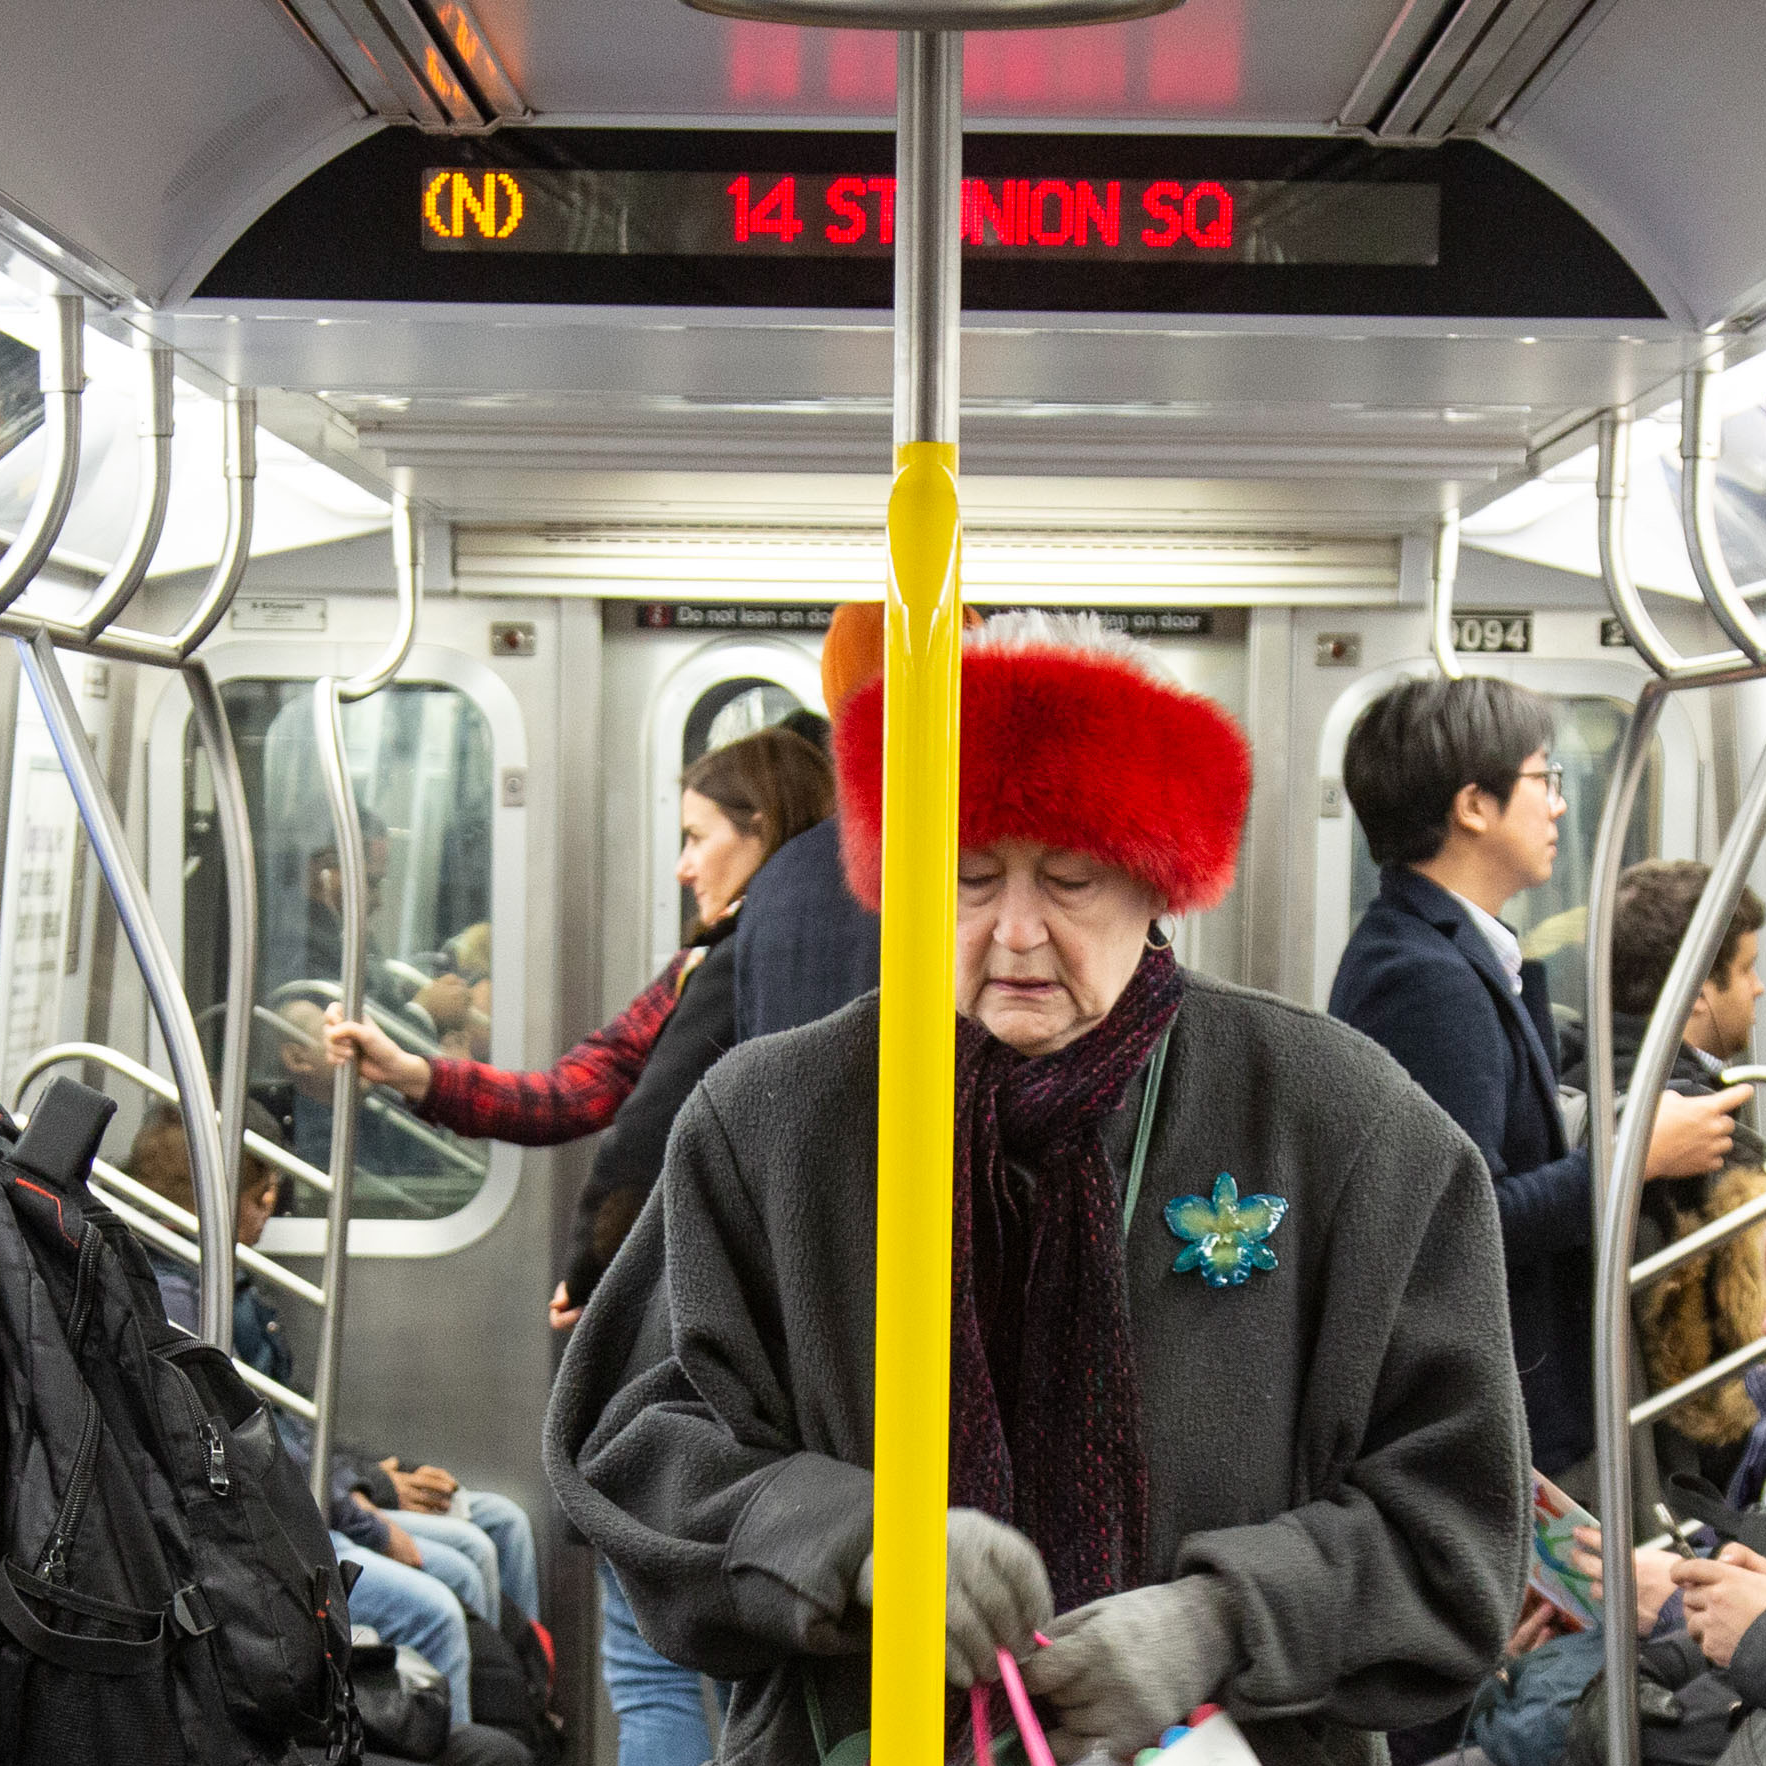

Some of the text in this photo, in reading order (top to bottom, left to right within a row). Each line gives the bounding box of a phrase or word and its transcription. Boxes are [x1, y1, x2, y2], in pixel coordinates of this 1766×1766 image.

[727, 175, 1233, 247] 14 ST NION SQ
[678, 605, 704, 623] Do
[707, 608, 736, 624] not
[741, 608, 778, 624] lean
[782, 611, 804, 624] on
[1134, 614, 1155, 627] on
[1161, 612, 1201, 627] door
